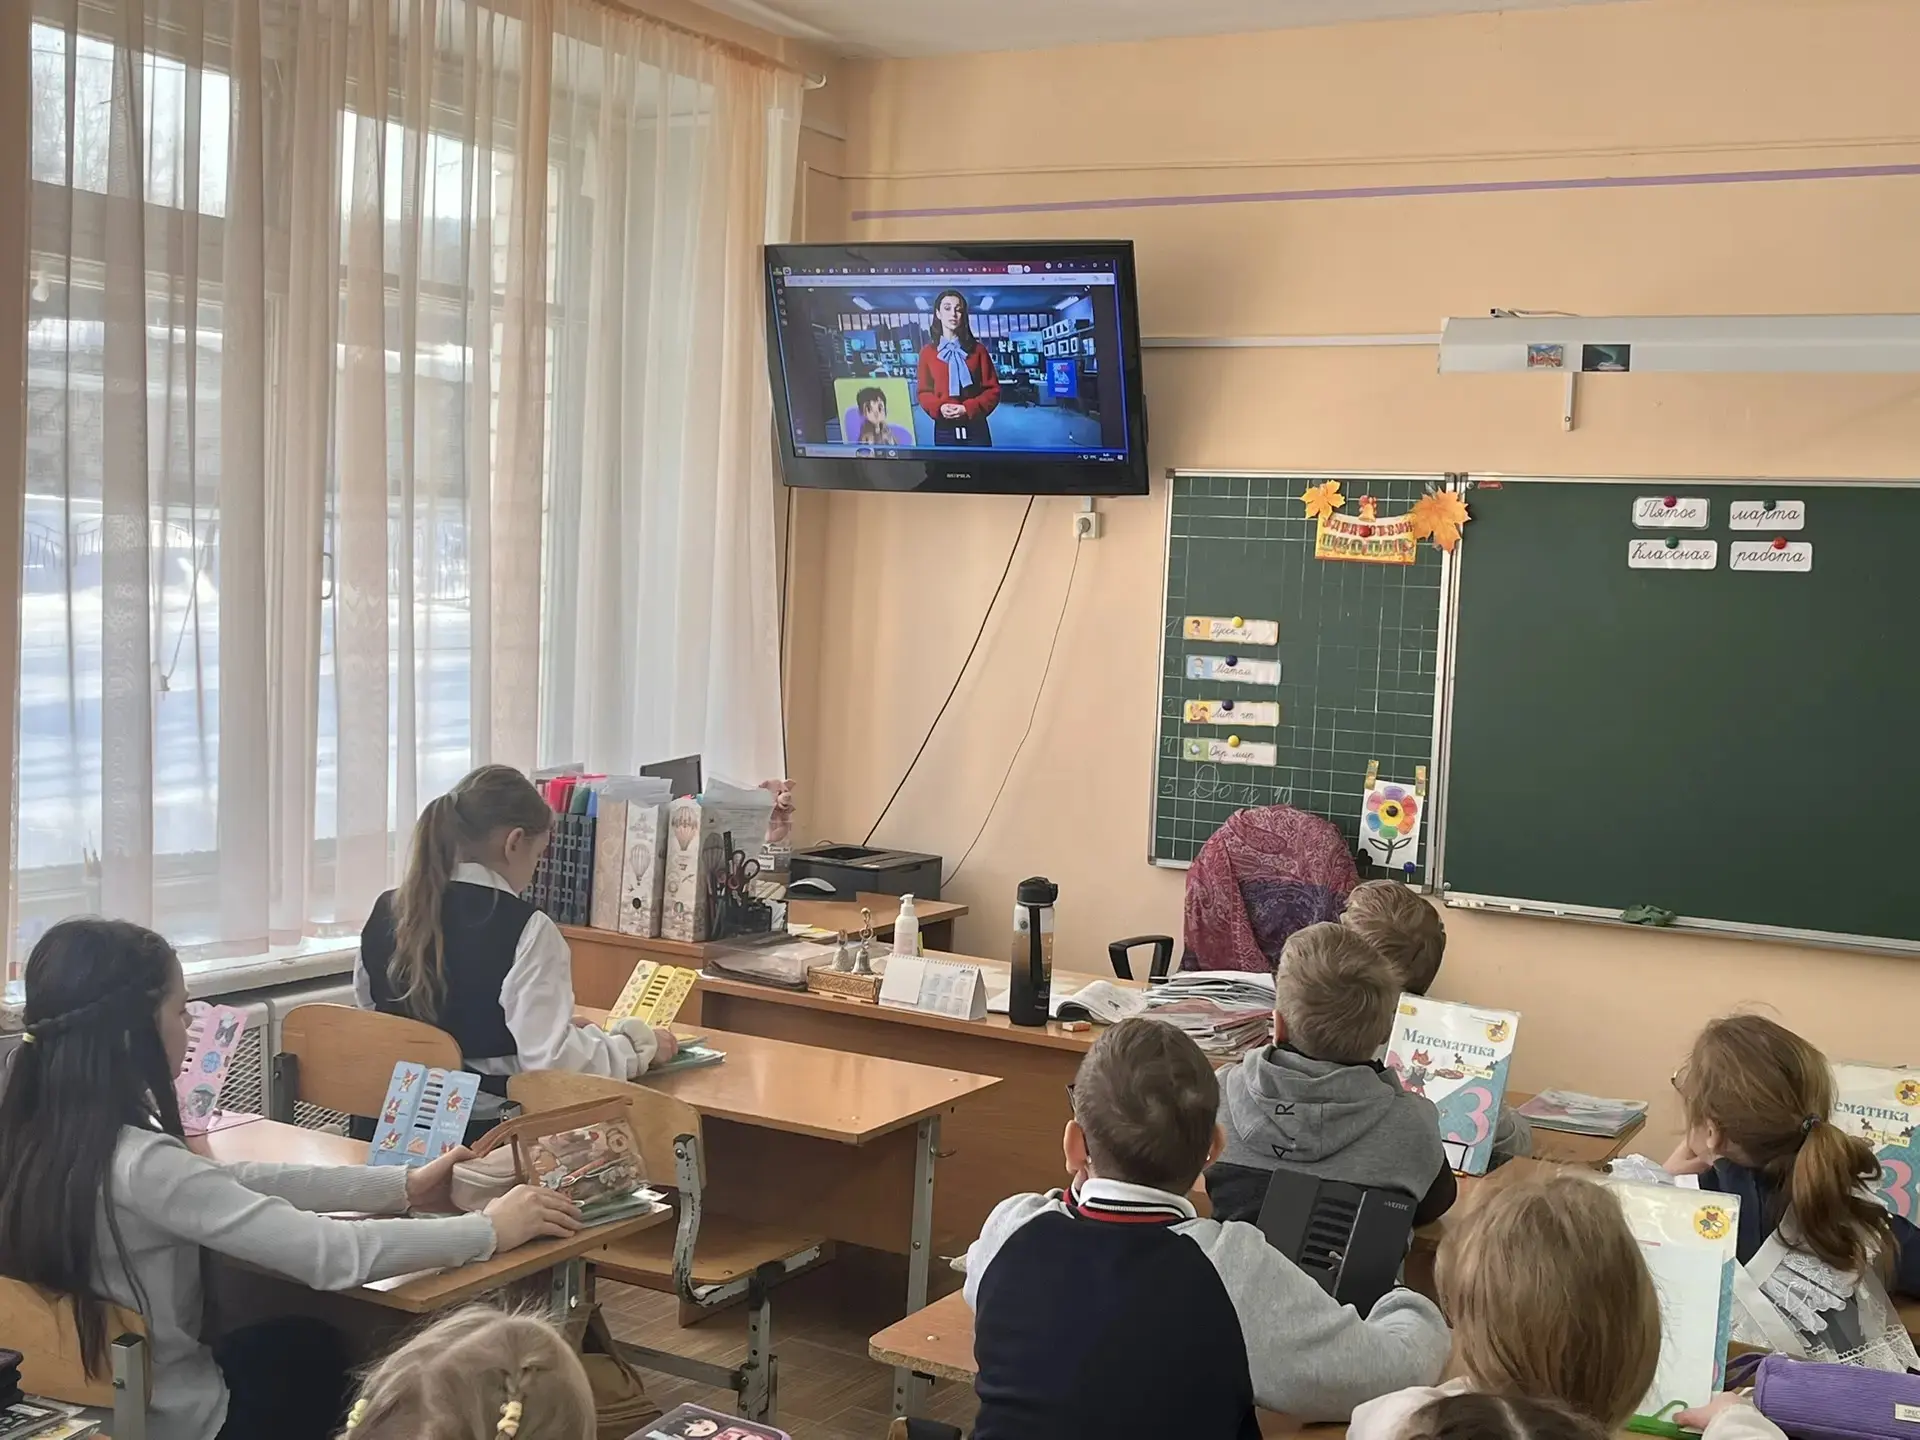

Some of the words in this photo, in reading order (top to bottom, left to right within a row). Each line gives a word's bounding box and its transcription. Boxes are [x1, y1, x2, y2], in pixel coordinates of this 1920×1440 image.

[1638, 499, 1697, 519] Пятое
[1731, 508, 1802, 528] марта
[1631, 541, 1712, 561] Классная
[1732, 543, 1806, 568] работа
[1401, 1027, 1496, 1058] Математика
[1447, 1086, 1493, 1147] 3
[1833, 1100, 1910, 1123] ематика
